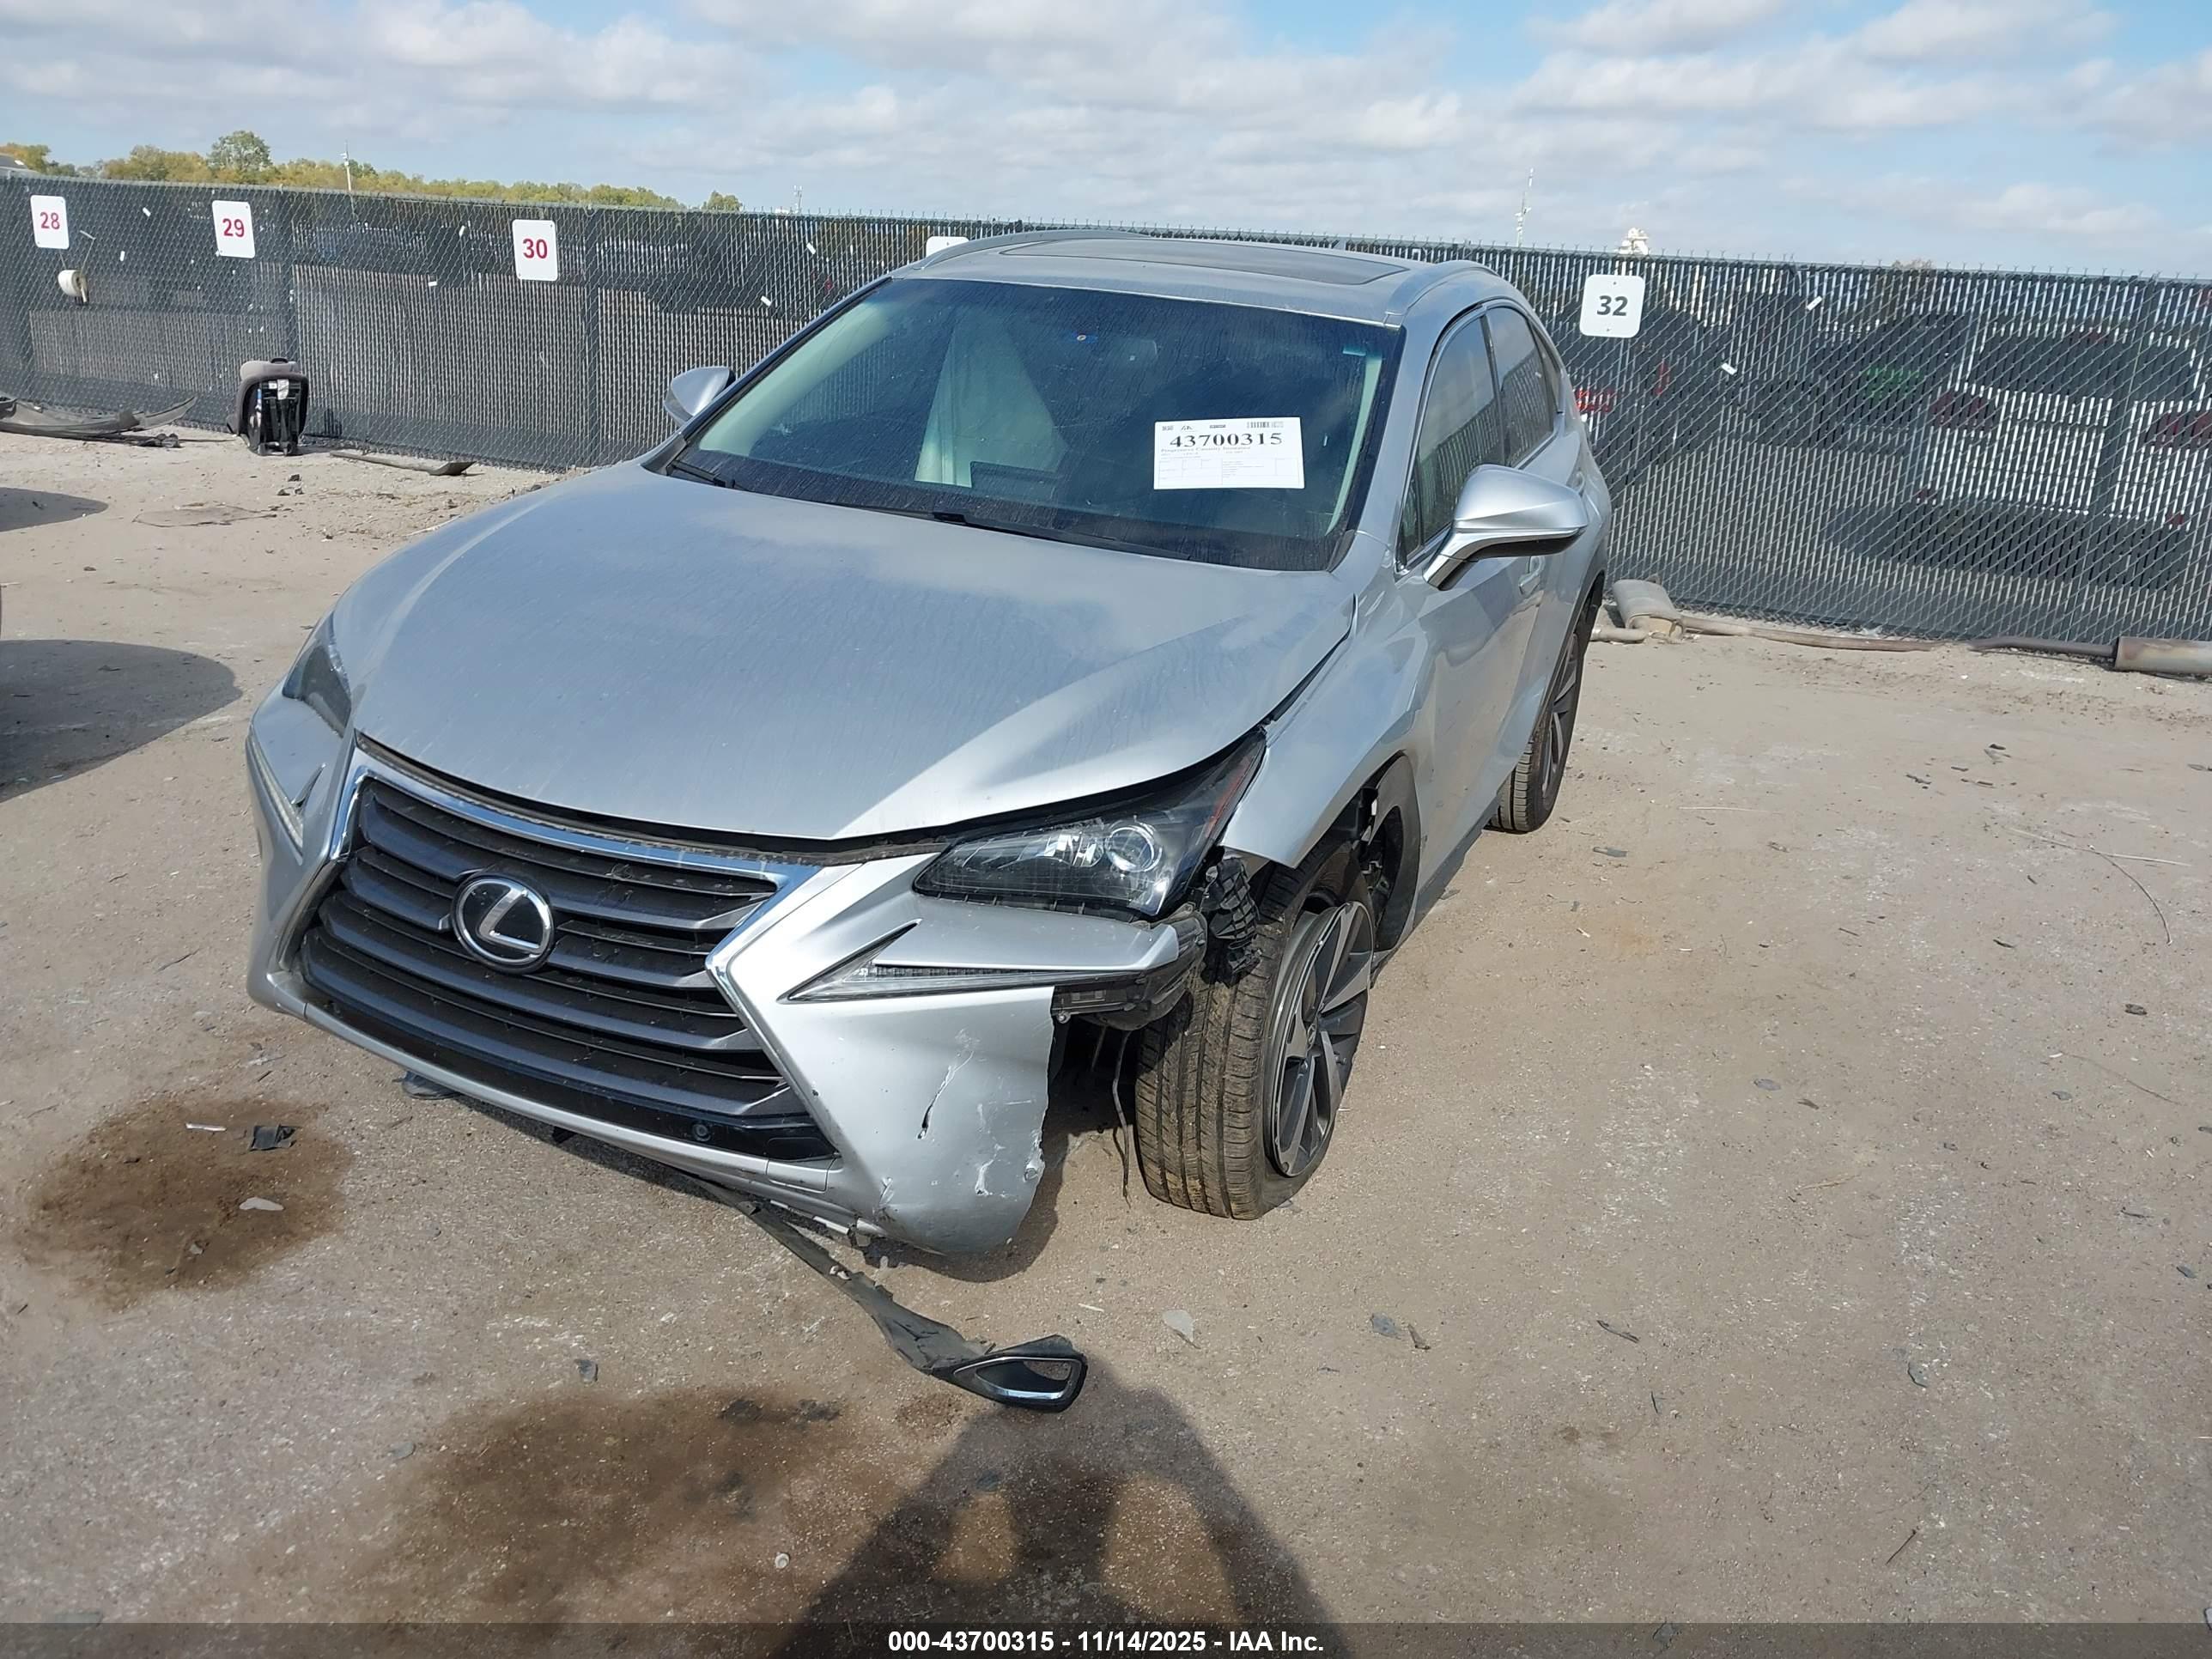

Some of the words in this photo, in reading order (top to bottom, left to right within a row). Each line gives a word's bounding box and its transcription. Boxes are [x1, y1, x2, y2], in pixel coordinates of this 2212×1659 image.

[40, 211, 60, 230] 28
[222, 218, 245, 238] 29
[522, 238, 548, 258] 30
[1596, 295, 1628, 316] 32
[1170, 432, 1283, 447] 43700315
